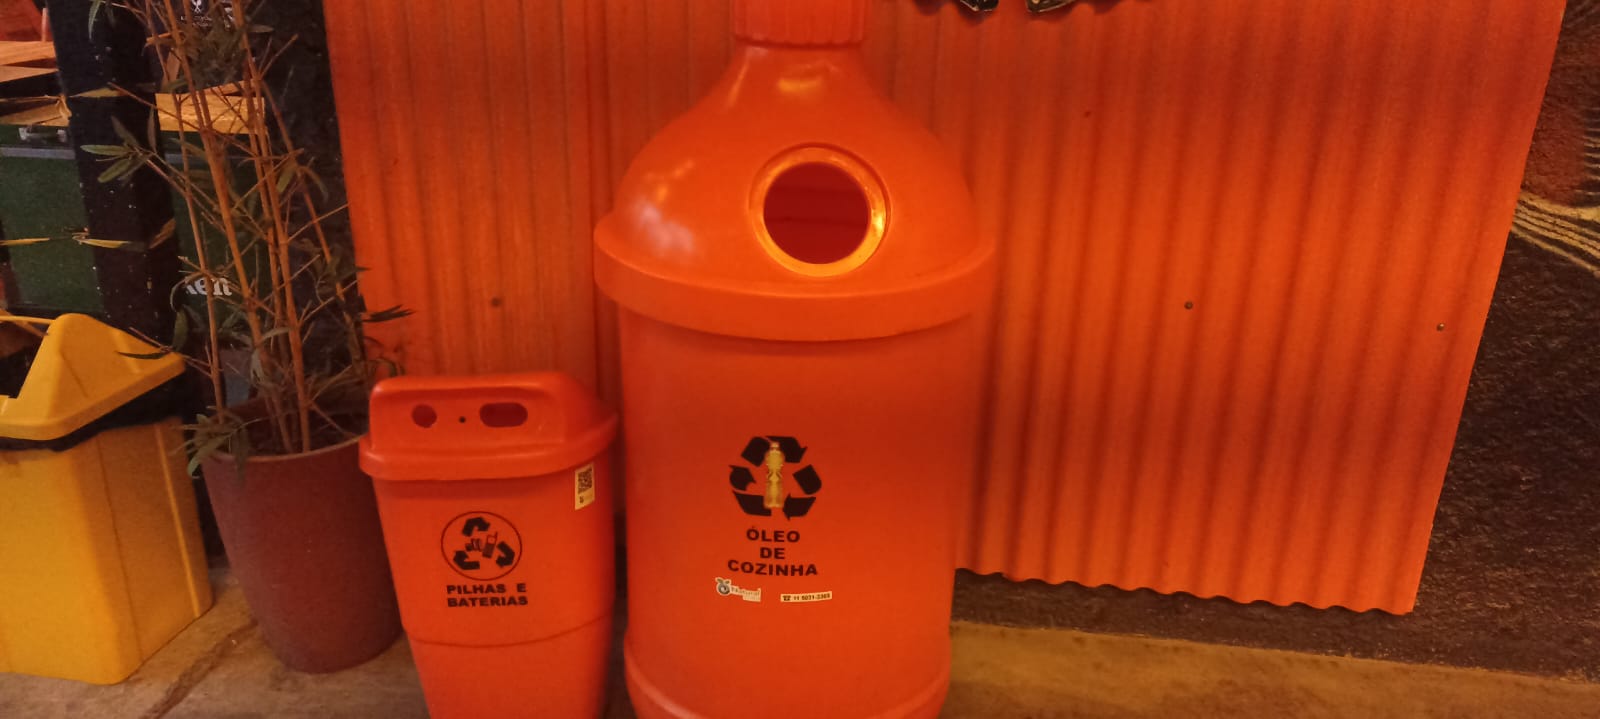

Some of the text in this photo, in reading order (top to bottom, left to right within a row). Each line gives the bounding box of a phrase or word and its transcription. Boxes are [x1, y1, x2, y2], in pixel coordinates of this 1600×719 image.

[746, 526, 800, 542] ÓLEO
[760, 547, 785, 559] DE
[728, 560, 817, 576] COZINHA
[447, 583, 526, 594] PILHAS E
[447, 596, 528, 607] BATERIAS
